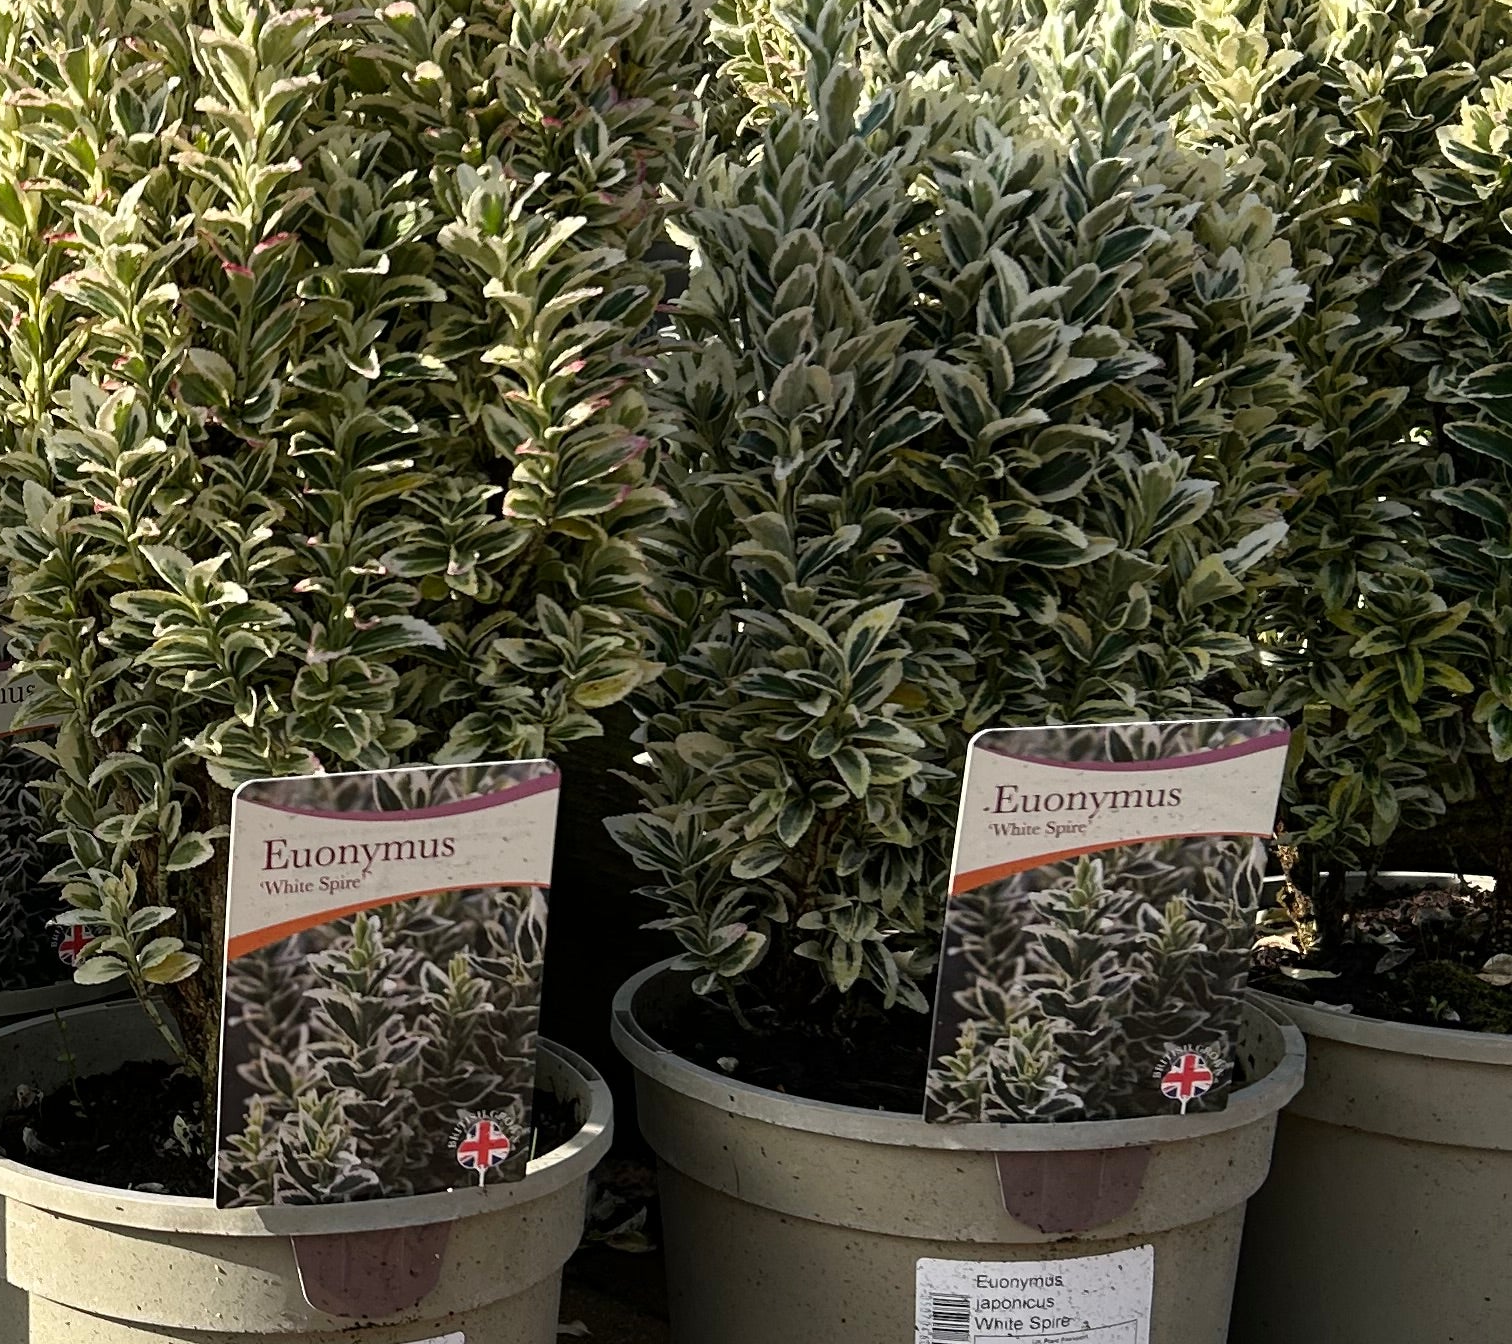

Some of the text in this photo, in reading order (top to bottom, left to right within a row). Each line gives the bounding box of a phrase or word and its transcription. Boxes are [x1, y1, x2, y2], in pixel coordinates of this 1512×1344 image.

[992, 784, 1182, 819] Euonymus
[989, 819, 1092, 838] 'White Spire'
[261, 836, 455, 874] Euonymus
[260, 873, 367, 896] 'White Spire'
[976, 1274, 1063, 1290] Euonymus
[976, 1298, 1055, 1313] japonicus
[975, 1316, 1072, 1333] White Spire
